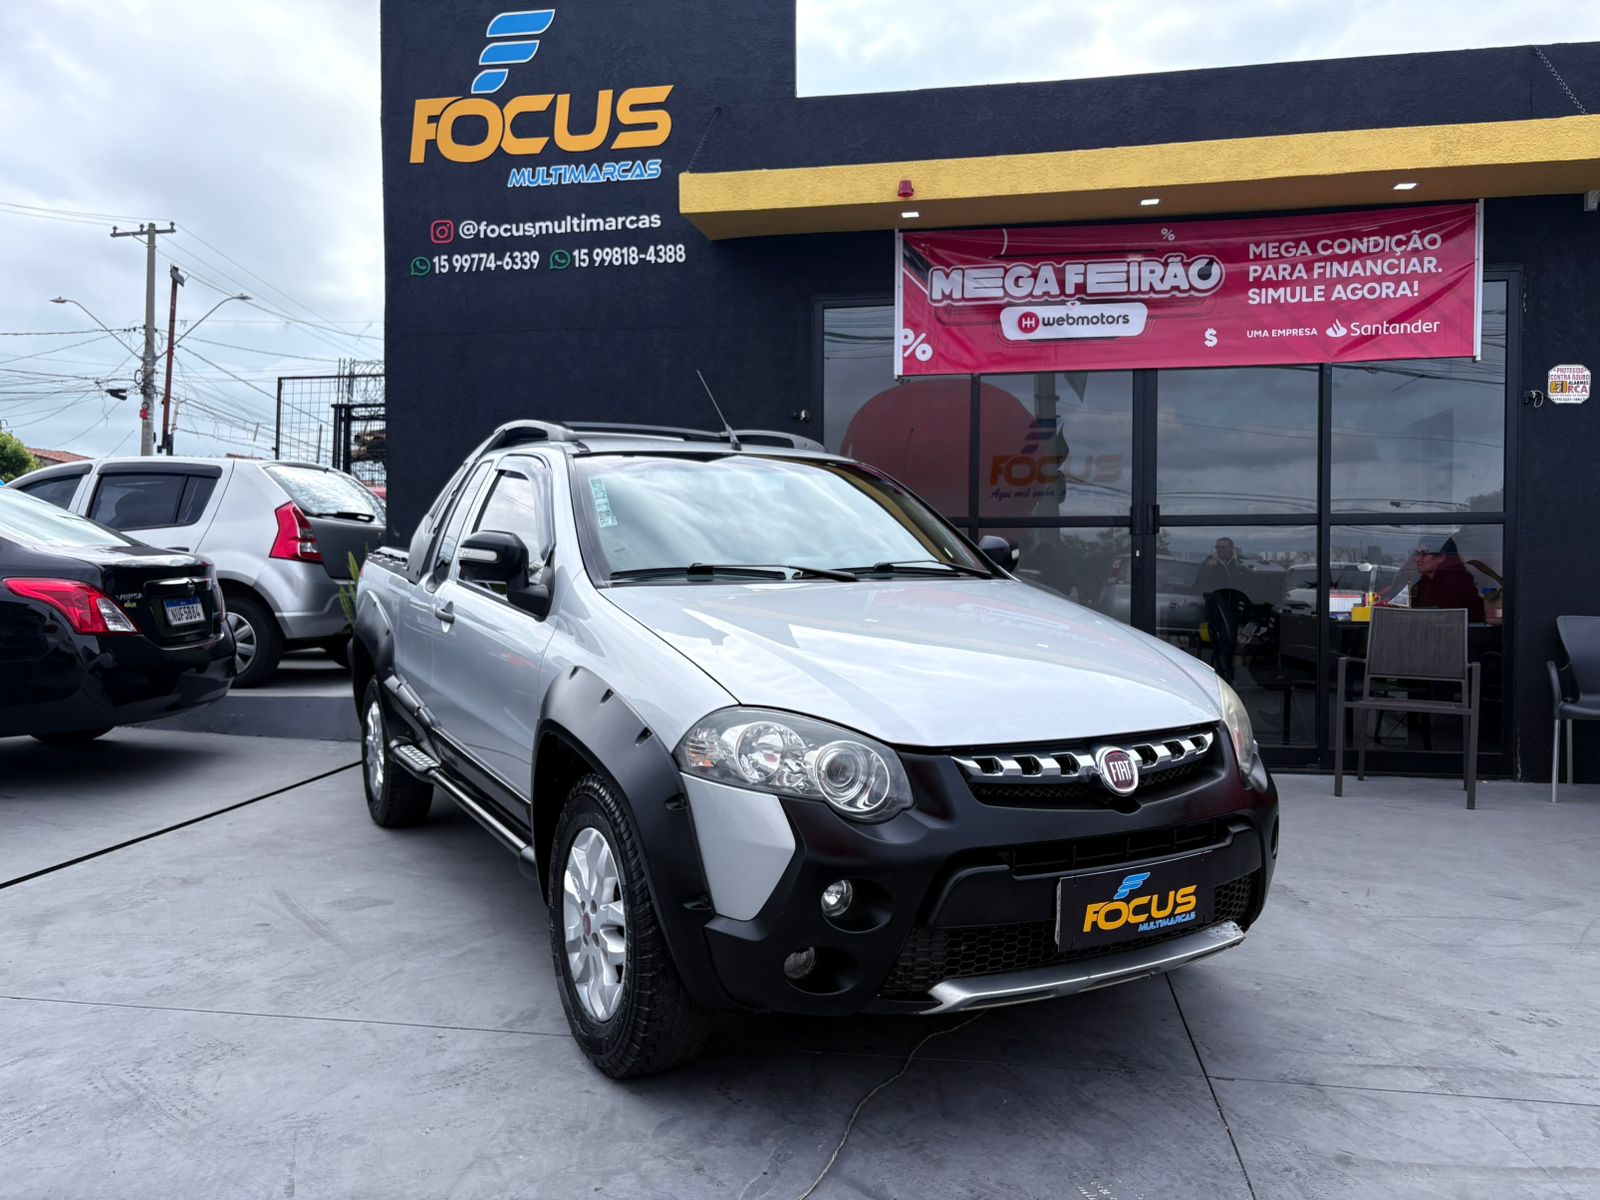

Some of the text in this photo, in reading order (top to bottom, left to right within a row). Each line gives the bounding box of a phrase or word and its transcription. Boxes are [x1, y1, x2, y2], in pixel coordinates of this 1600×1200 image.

[409, 85, 674, 164] FOCUS
[507, 159, 662, 187] MULTIMARCAS
[573, 244, 686, 267] 15 99818-4388
[1249, 230, 1442, 260] MEGA CONDIÇÃO
[433, 250, 540, 274] 15 99774-6339
[1249, 256, 1443, 282] PARA FINANCIAR.
[1248, 280, 1419, 305] SIMULE AGORA!
[1042, 311, 1130, 328] webmotors
[1350, 319, 1440, 337] Santander
[1246, 327, 1318, 339] UMA EMPRESA
[1568, 385, 1588, 393] RCA
[990, 454, 1123, 487] FOCUS
[1109, 760, 1132, 782] FIAT
[1083, 885, 1197, 933] FOCUS
[1138, 912, 1197, 933] MULTIMARCAS
